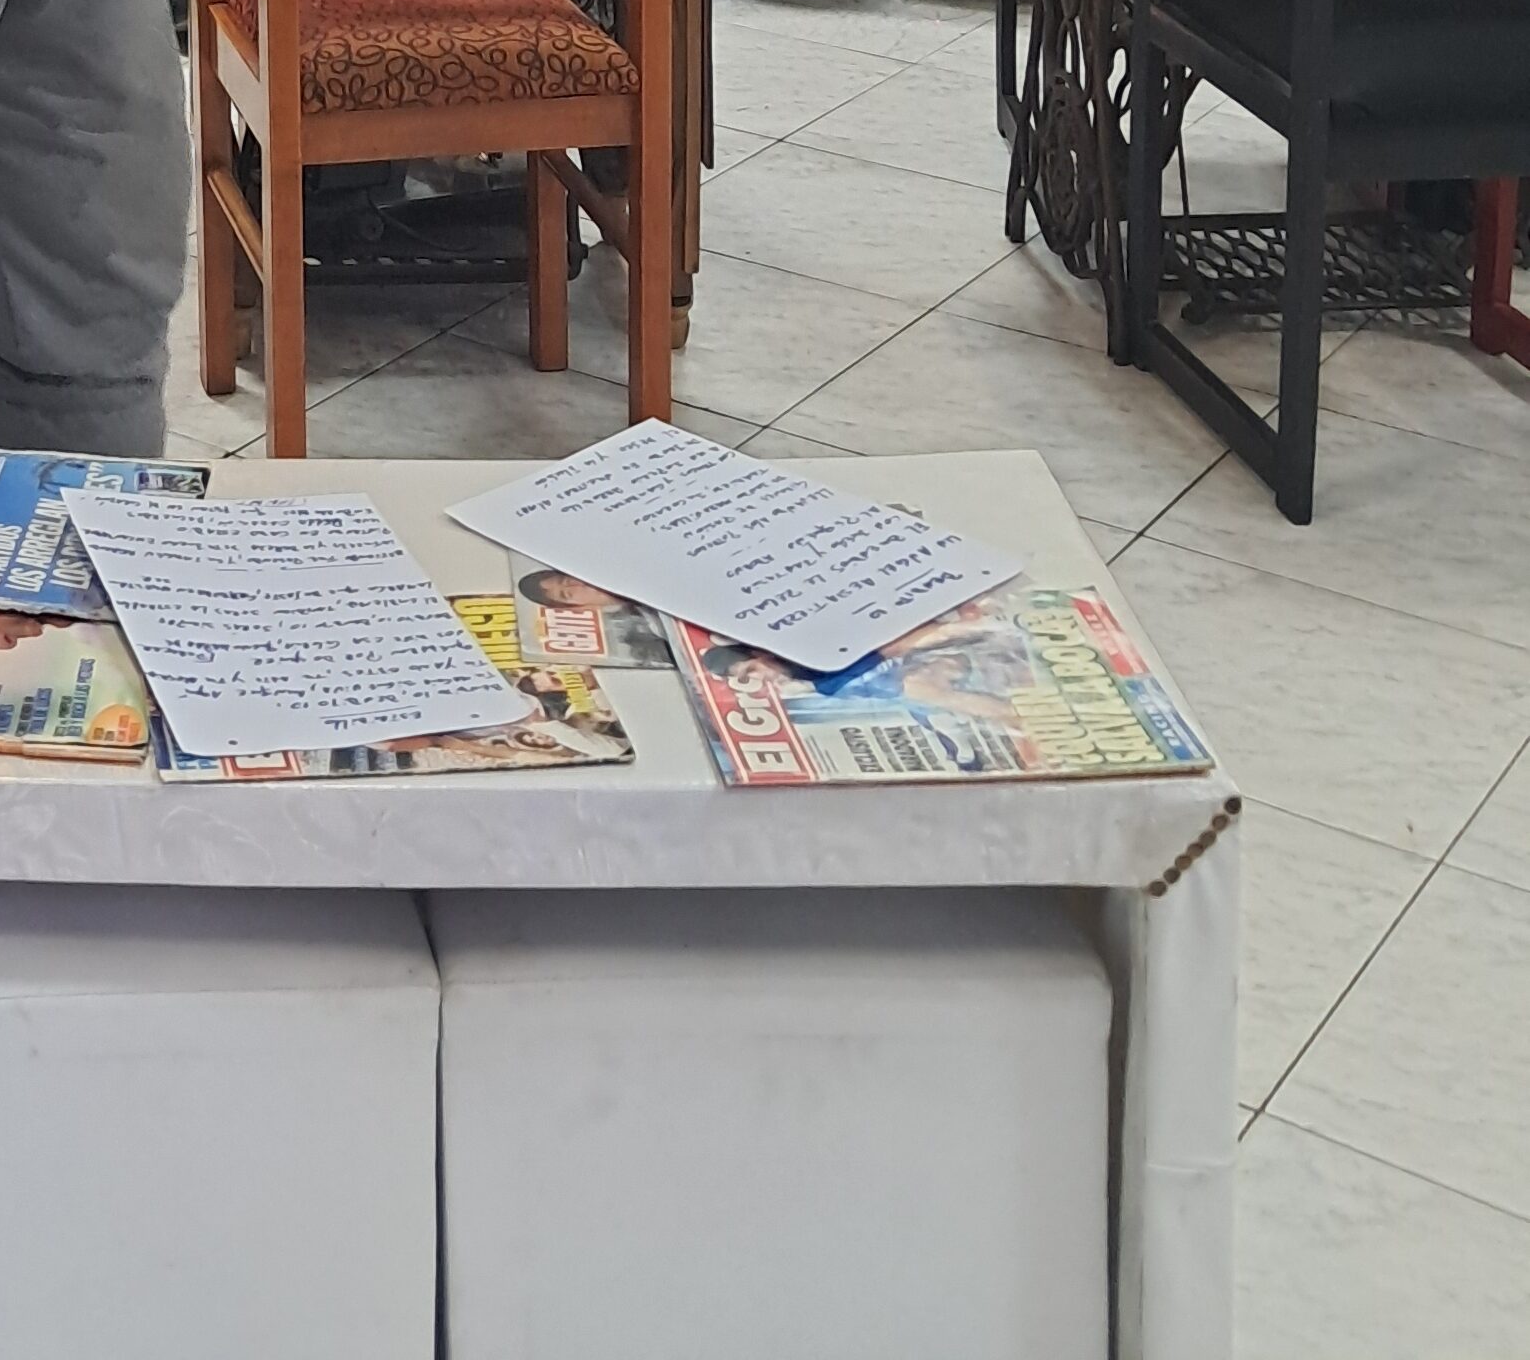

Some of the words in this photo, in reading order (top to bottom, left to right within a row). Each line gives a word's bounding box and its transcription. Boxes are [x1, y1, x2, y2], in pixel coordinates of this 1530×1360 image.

[5, 565, 44, 592] LOS
[51, 554, 92, 590] LOS
[545, 608, 600, 652] GENTE
